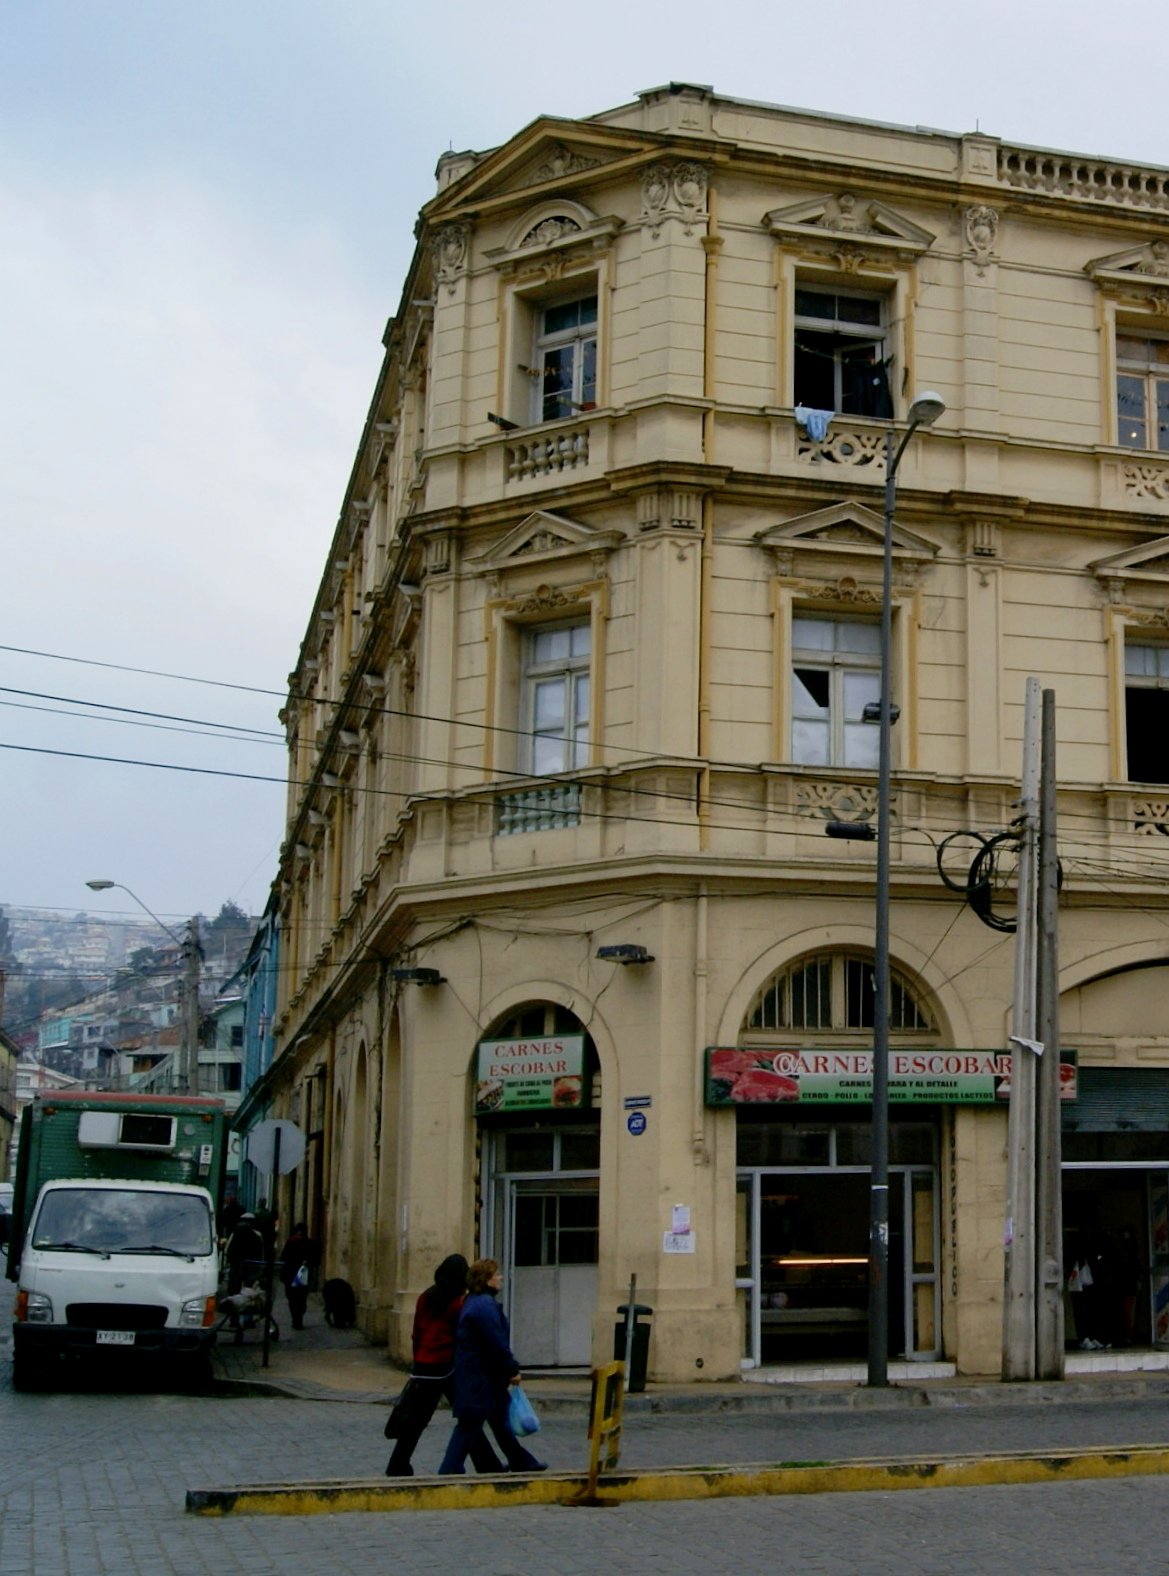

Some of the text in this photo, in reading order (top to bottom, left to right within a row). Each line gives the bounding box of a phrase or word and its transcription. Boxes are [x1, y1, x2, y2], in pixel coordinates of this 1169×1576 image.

[494, 1041, 564, 1058] CARNES
[489, 1060, 567, 1077] ESCOBAR
[773, 1053, 1012, 1075] CARNE ESCOBAR
